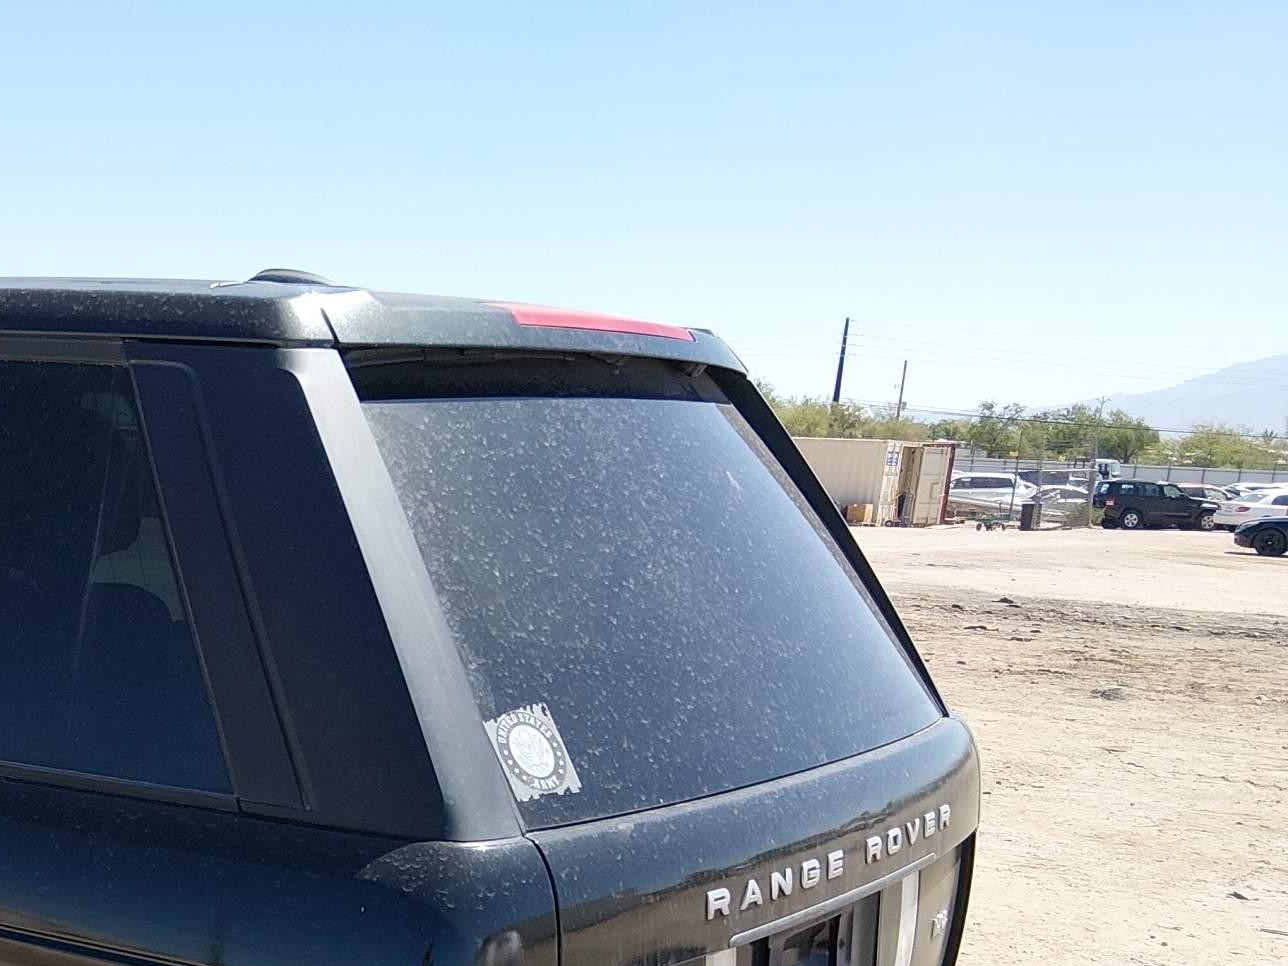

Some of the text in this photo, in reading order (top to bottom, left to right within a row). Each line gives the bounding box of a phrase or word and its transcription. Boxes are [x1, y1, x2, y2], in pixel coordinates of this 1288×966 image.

[497, 712, 553, 744] UNITED STATES
[529, 775, 560, 790] ARMY
[706, 804, 952, 921] RANGE ROVER
